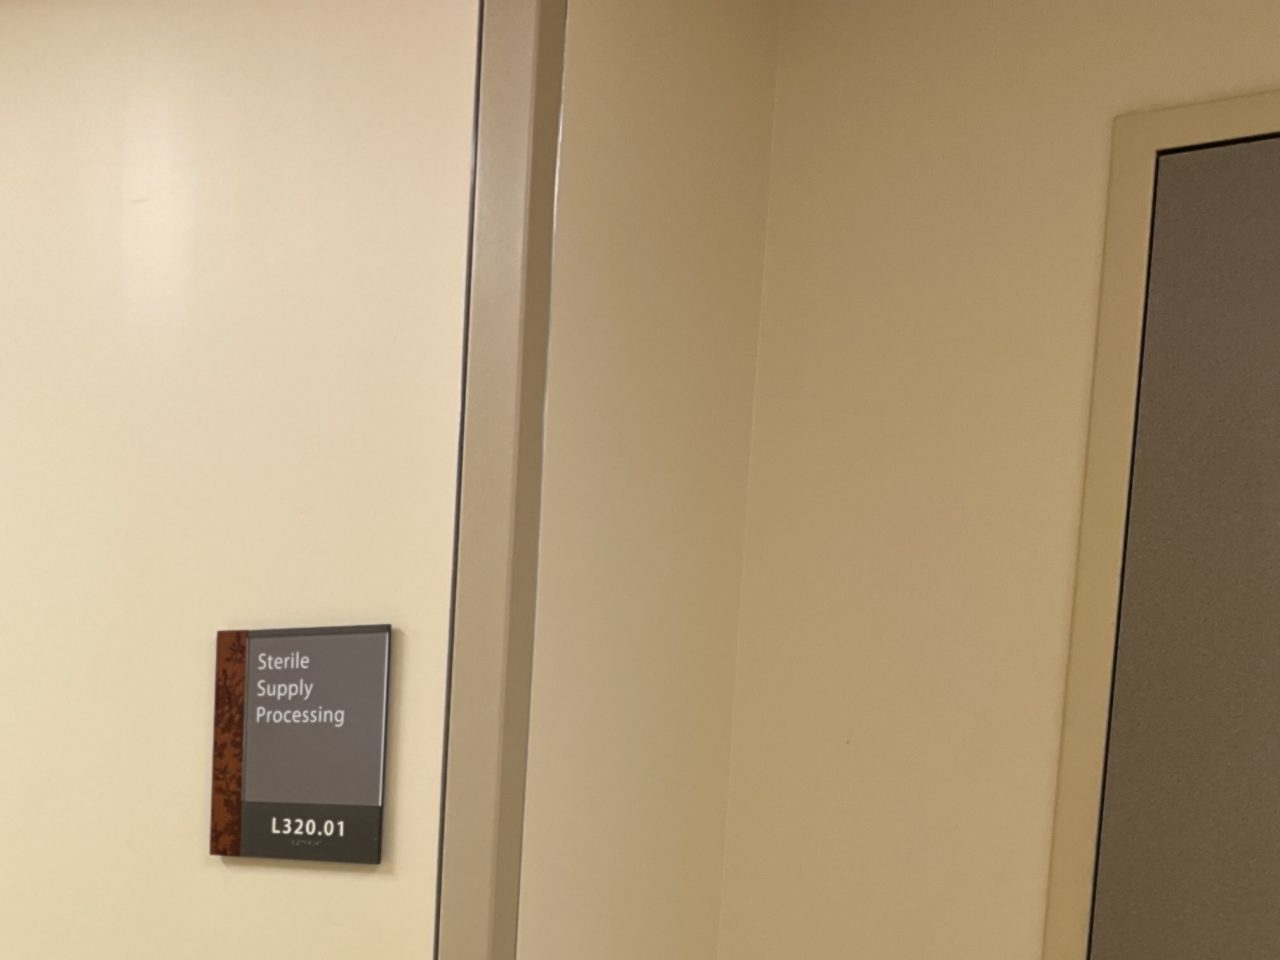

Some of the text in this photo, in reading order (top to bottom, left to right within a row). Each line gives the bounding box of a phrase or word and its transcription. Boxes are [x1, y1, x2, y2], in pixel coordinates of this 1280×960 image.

[257, 651, 310, 670] Sterile
[256, 678, 314, 701] Supply
[255, 706, 345, 727] Processing
[271, 817, 345, 837] L320.01
